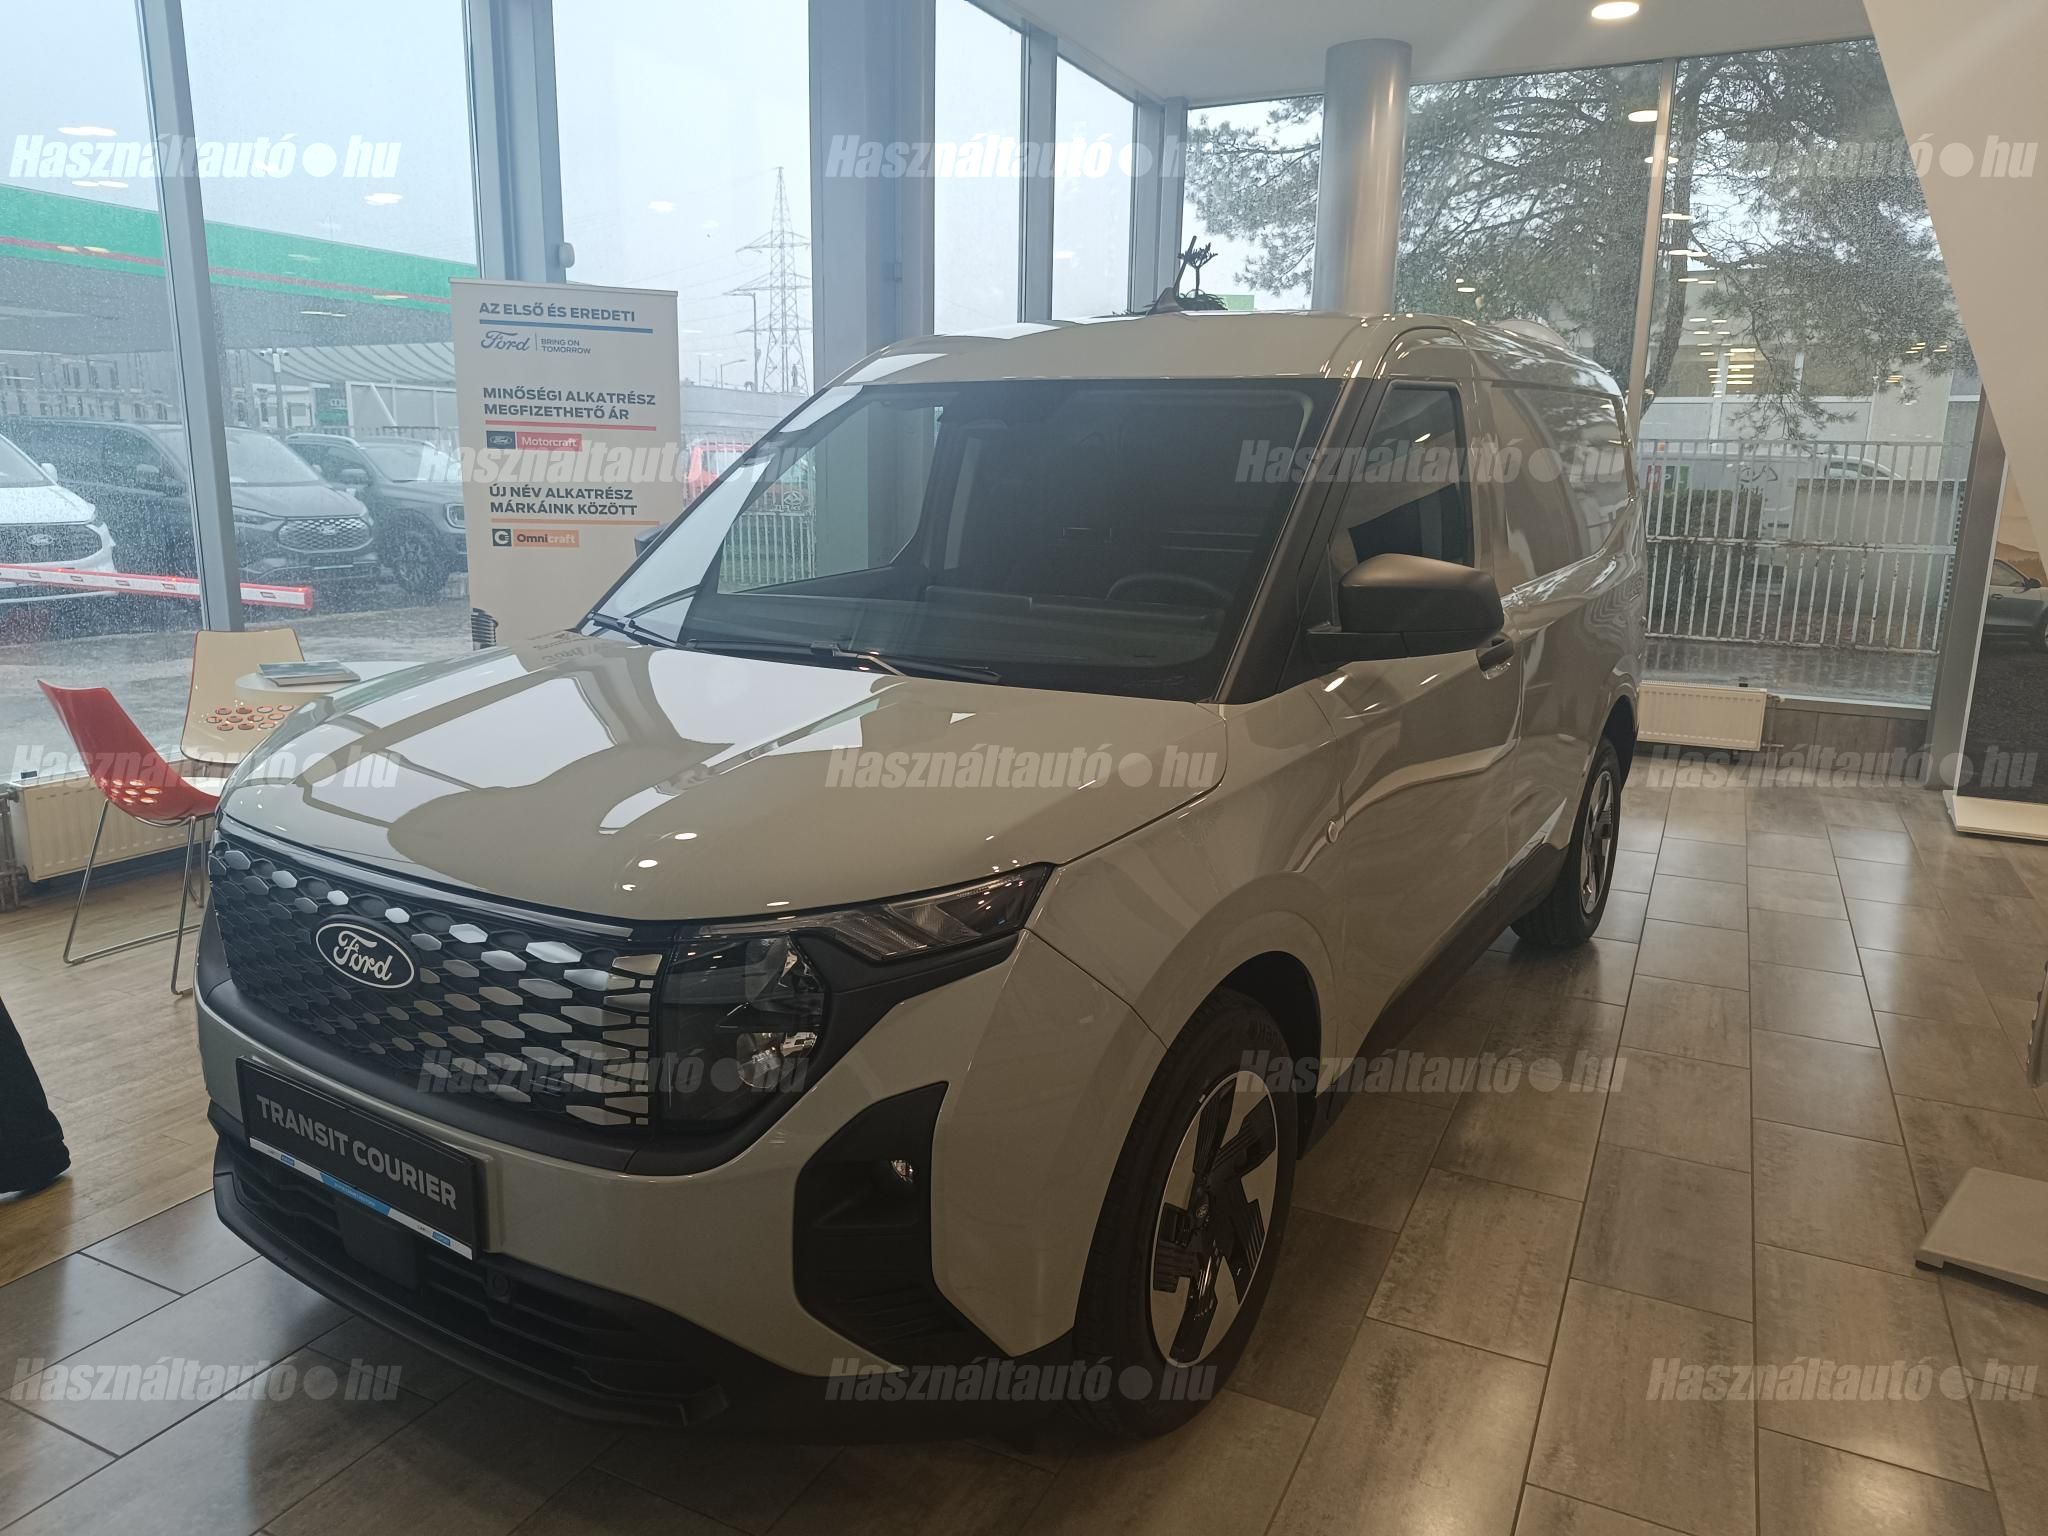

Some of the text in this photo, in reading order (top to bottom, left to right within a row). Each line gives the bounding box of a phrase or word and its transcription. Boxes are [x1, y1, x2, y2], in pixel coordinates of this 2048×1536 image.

[479, 302, 635, 322] AZ ELSŐ ÉS EREDETI
[480, 330, 580, 352] Ford BRING ON
[541, 345, 591, 355] TOMORROW
[483, 386, 656, 406] MINŐSÉGI ALKATRÉSZ
[484, 403, 629, 420] MEGFIZETHETŐ ÁR
[521, 436, 577, 447] Motorcraft
[489, 483, 633, 501] ÚJ NÉV ALKATRÉSZ
[490, 500, 638, 516] MÁRKÁINK KÖZÖTT
[516, 533, 576, 544] Omnicraft
[333, 930, 394, 981] Ford
[256, 1094, 457, 1210] TRANSIT COURIER
